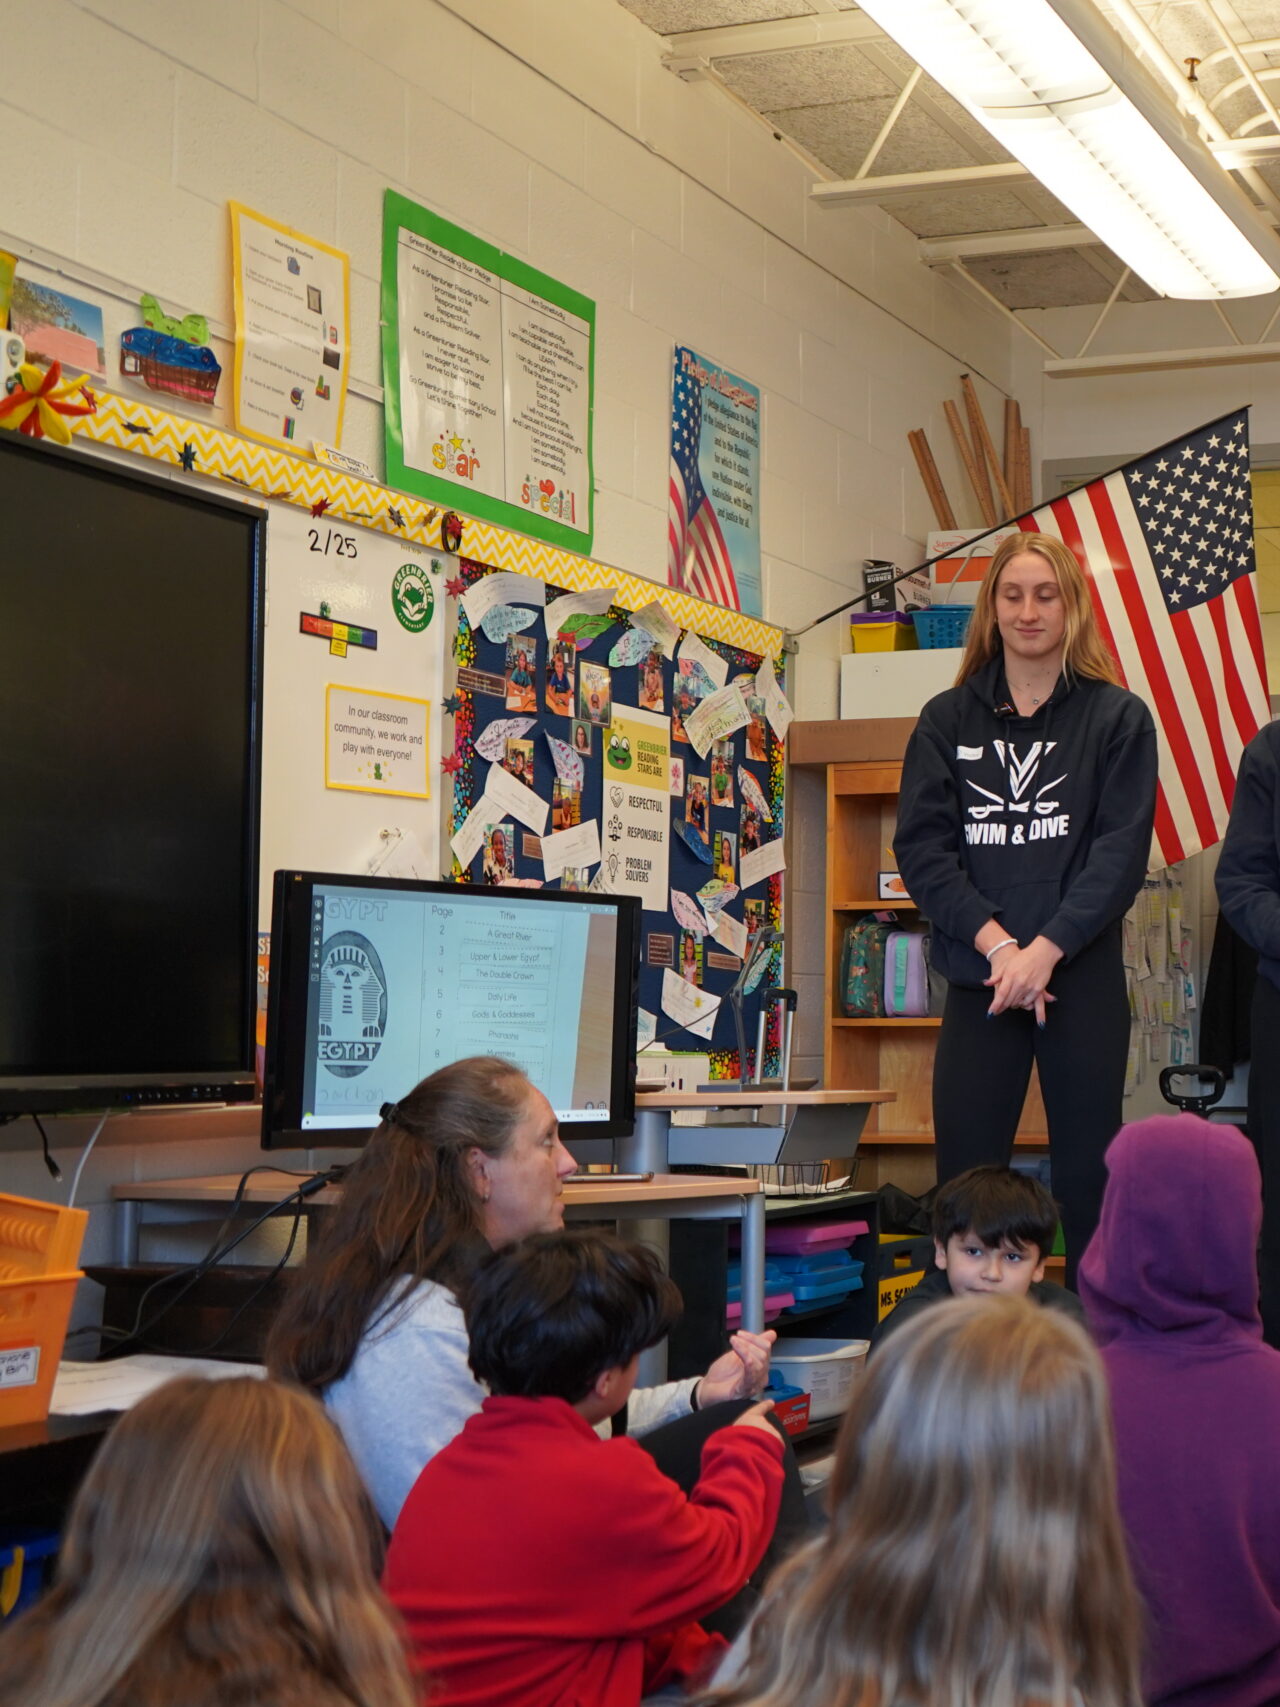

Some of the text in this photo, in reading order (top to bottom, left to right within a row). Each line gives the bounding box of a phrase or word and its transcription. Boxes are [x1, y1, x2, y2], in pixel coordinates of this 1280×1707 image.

[439, 251, 462, 268] Reading
[454, 284, 478, 302] Reading
[457, 344, 480, 360] Reading
[681, 350, 708, 388] Pledge
[308, 528, 358, 558] 2/25
[394, 565, 434, 604] GREENBRIER
[867, 574, 892, 584] BURNER
[398, 612, 424, 628] ELEMENTARY
[348, 704, 408, 726] In our classroom
[334, 722, 422, 745] community, we work and
[343, 741, 412, 761] play with everyone!
[637, 740, 668, 756] GREENBRIER
[637, 752, 660, 766] READING
[637, 762, 663, 777] STARS ARE
[628, 795, 664, 814] RESPECTFUL
[626, 826, 663, 843] RESPONSIBLE
[1011, 824, 1026, 845] &
[1028, 814, 1070, 841] DIVE
[626, 857, 652, 872] PROBLEM
[625, 870, 649, 883] SOLVERS
[325, 896, 389, 922] GYPT
[432, 904, 516, 920] Page Title
[440, 924, 445, 936] 2
[494, 930, 514, 940] Great
[516, 932, 532, 941] River
[439, 946, 540, 963] 3 Upper & Lower Egypt
[438, 966, 534, 980] 4 The Double Crown
[437, 988, 518, 1002] 5 Daily Life
[436, 1009, 536, 1020] 6 Gods & Goddesses
[436, 1028, 519, 1040] 7 Pharaohs
[318, 1042, 376, 1060] EGYPT
[487, 1049, 516, 1058] Mummies
[880, 1291, 894, 1308] MS.
